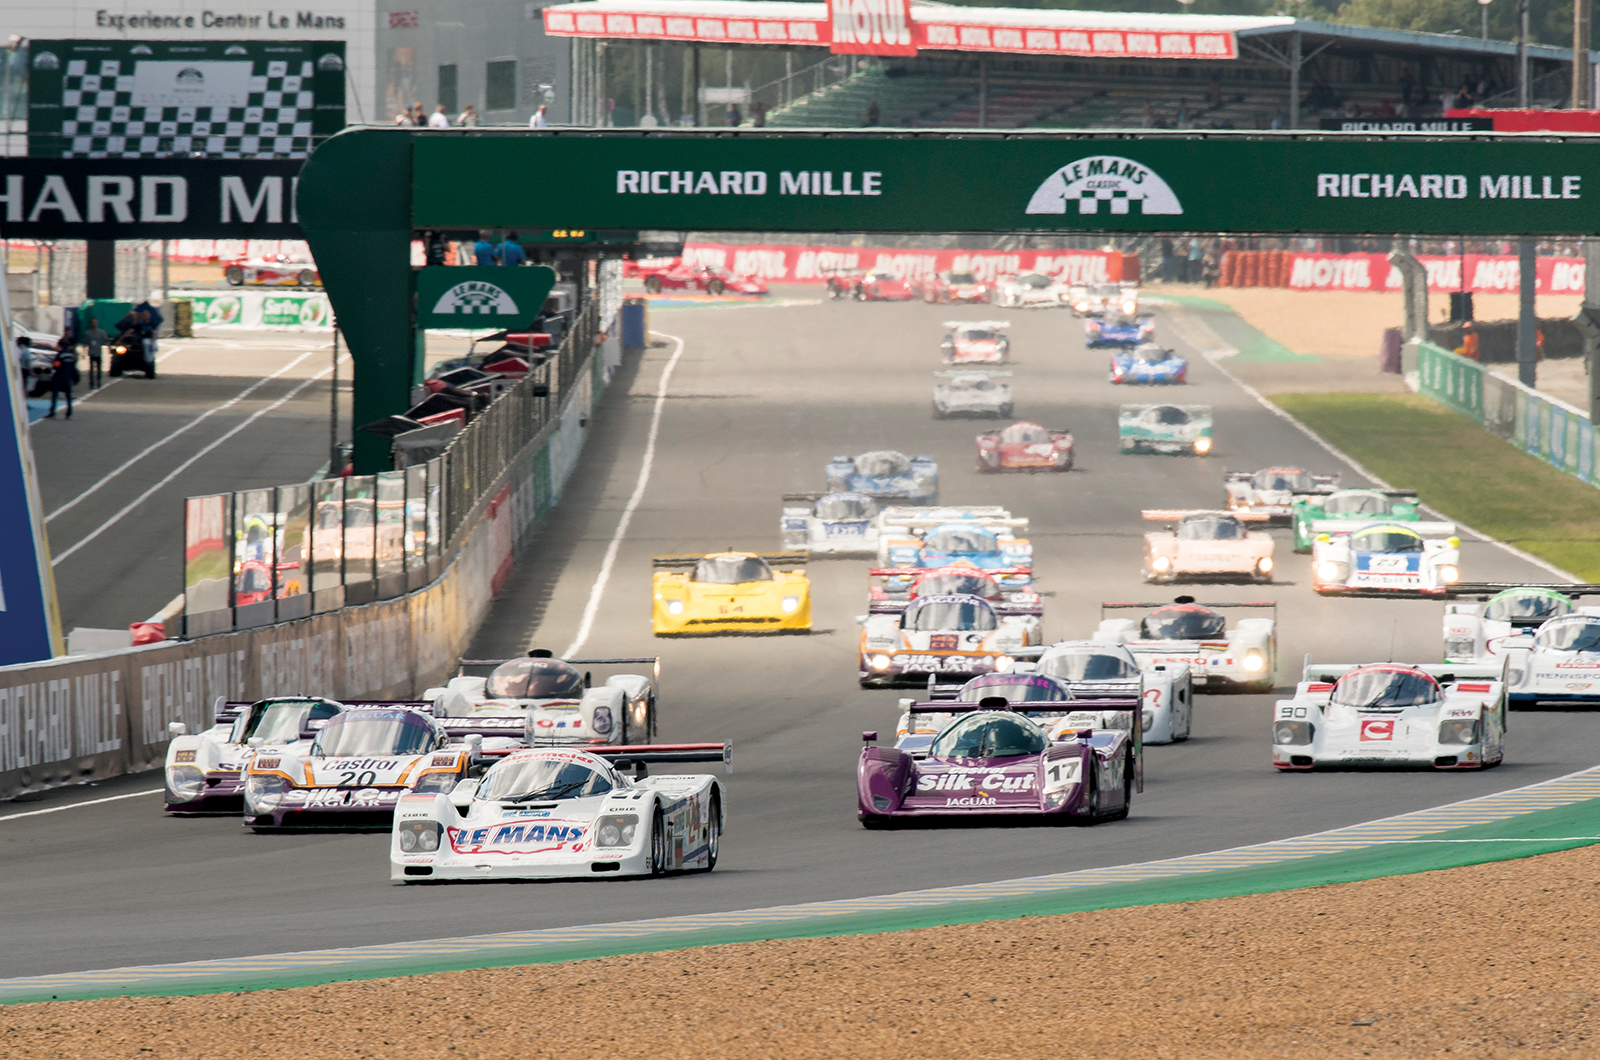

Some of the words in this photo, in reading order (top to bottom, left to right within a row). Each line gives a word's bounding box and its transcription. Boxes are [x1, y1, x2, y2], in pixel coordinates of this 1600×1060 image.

[96, 10, 195, 32] Experience
[202, 11, 262, 28] Center
[267, 11, 289, 29] Le
[296, 12, 345, 29] Mans
[832, 0, 911, 45] MOTUL
[1061, 164, 1084, 186] LE
[1086, 159, 1148, 185] MANS
[616, 170, 767, 194] RICHARD
[779, 171, 882, 196] MILLE
[1317, 173, 1468, 198] RICHARD
[1479, 174, 1582, 199] MILLE
[1290, 258, 1371, 288] MOTUL
[973, 677, 1050, 689] JAGUAR
[343, 711, 406, 721] JAGUAR
[1281, 707, 1308, 718] 90
[478, 718, 526, 728] Cut
[322, 757, 400, 772] Castrol
[1048, 761, 1079, 783] 17
[337, 771, 377, 787] 20
[916, 774, 975, 791] Silk
[981, 774, 1036, 790] Cut
[284, 788, 344, 801] Silk
[349, 788, 413, 801] Cut
[946, 797, 997, 807] JAGUAR
[302, 800, 381, 809] JAGUAR
[454, 827, 490, 845] LE
[492, 825, 589, 845] MANS
